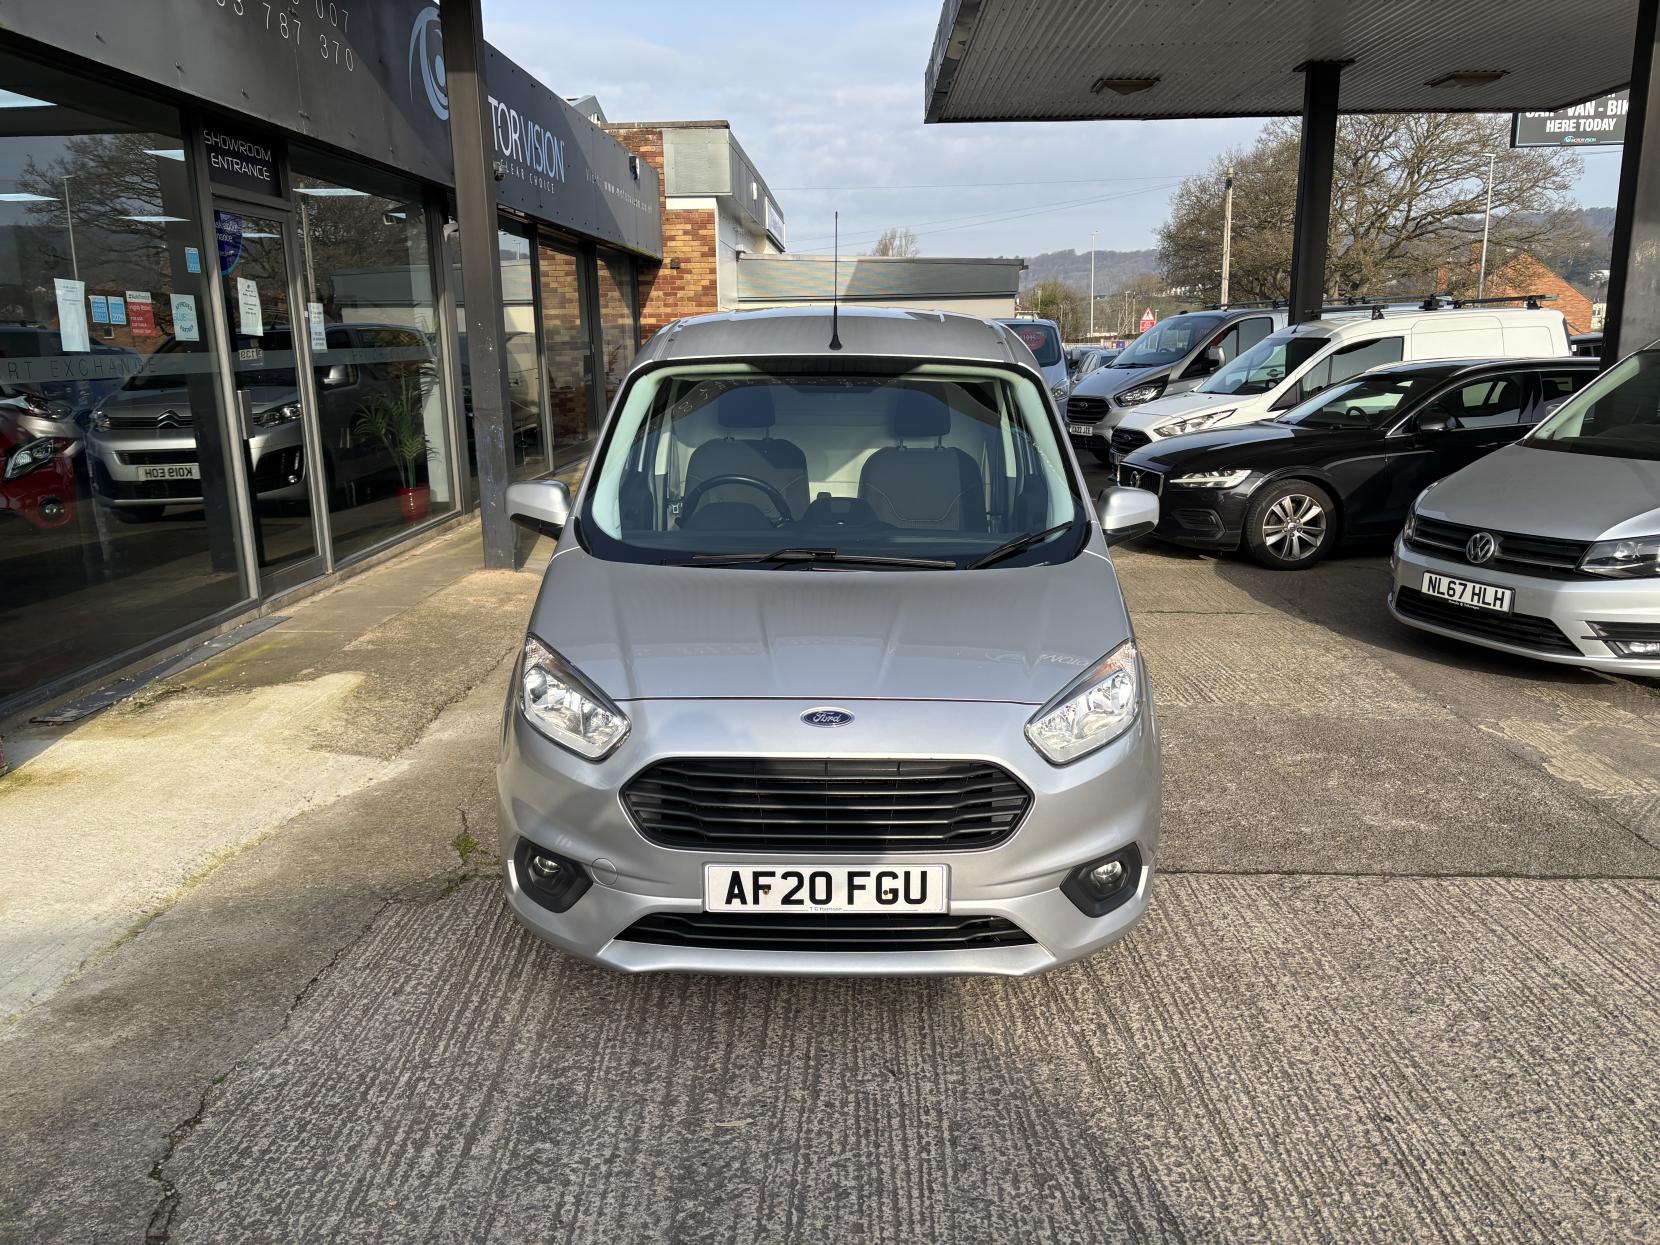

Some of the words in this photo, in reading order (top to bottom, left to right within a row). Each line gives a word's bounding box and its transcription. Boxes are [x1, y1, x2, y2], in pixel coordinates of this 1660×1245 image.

[262, 2, 301, 46] 787
[319, 34, 354, 72] 370
[1545, 119, 1577, 133] HERE
[1578, 118, 1617, 132] TODAY
[203, 129, 272, 162] SHOWROOM
[210, 152, 271, 181] ENTRANCE
[1427, 575, 1467, 599] NL67
[1470, 585, 1505, 609] HLH
[812, 711, 842, 723] Ford
[724, 870, 833, 906] AF20
[847, 870, 928, 906] FGU
